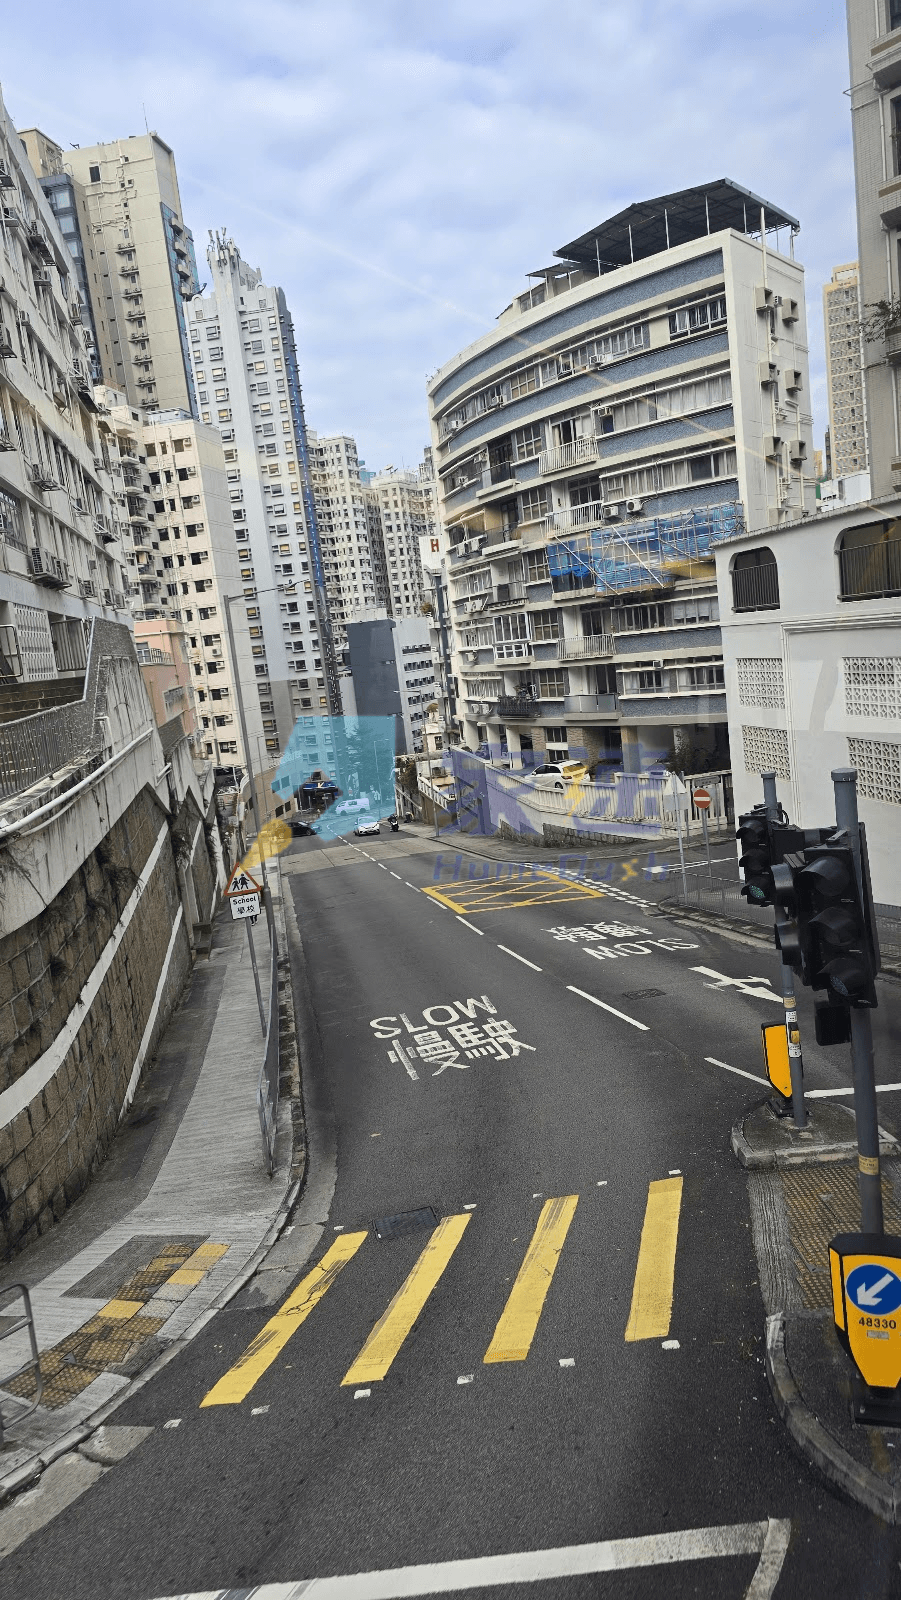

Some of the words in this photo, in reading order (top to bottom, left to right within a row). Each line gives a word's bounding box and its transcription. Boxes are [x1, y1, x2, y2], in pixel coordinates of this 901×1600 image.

[430, 539, 439, 552] H
[233, 896, 256, 905] School
[237, 905, 255, 914] 學校
[581, 937, 699, 960] SLOW
[369, 994, 498, 1039] SLOW
[387, 1017, 537, 1081] 慢駛
[858, 1317, 896, 1329] 48330
